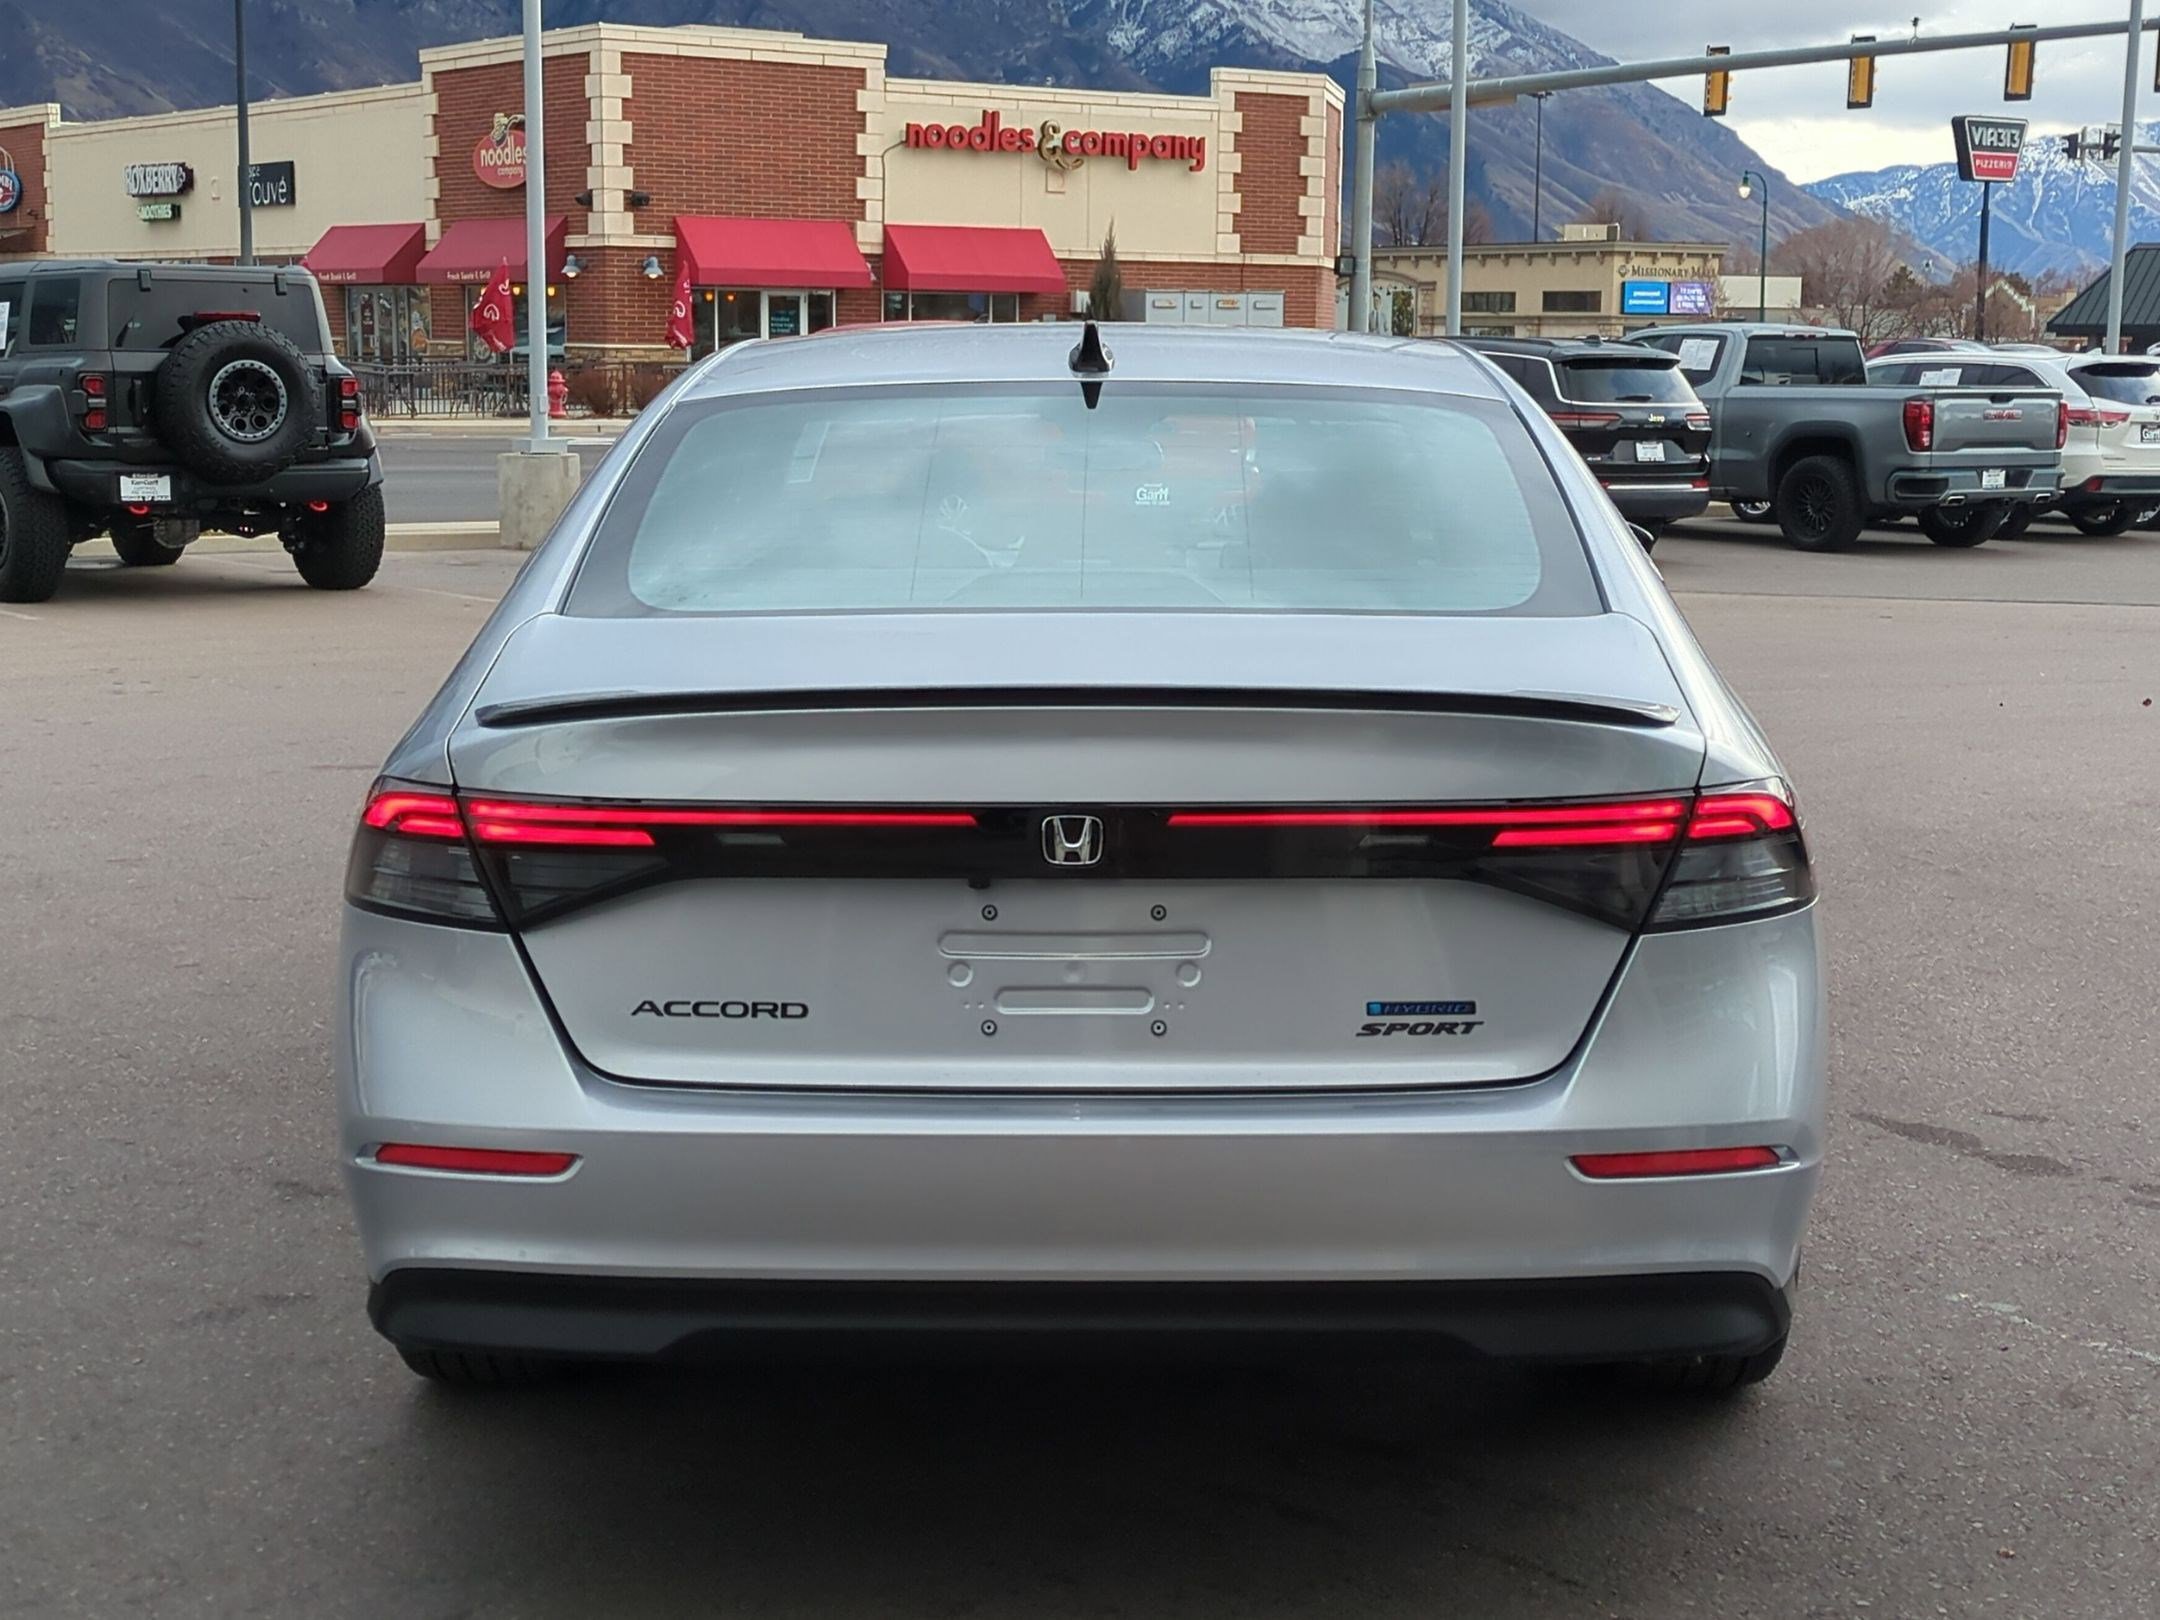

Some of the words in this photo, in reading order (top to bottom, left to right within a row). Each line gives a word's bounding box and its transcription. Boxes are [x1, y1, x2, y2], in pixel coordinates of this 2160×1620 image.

[906, 110, 1034, 151] noodles
[1038, 120, 1084, 171] &
[1062, 130, 1206, 172] company
[630, 999, 809, 1019] ACCORD
[1383, 1003, 1467, 1014] HYBRID
[1355, 1020, 1485, 1037] SPORT
